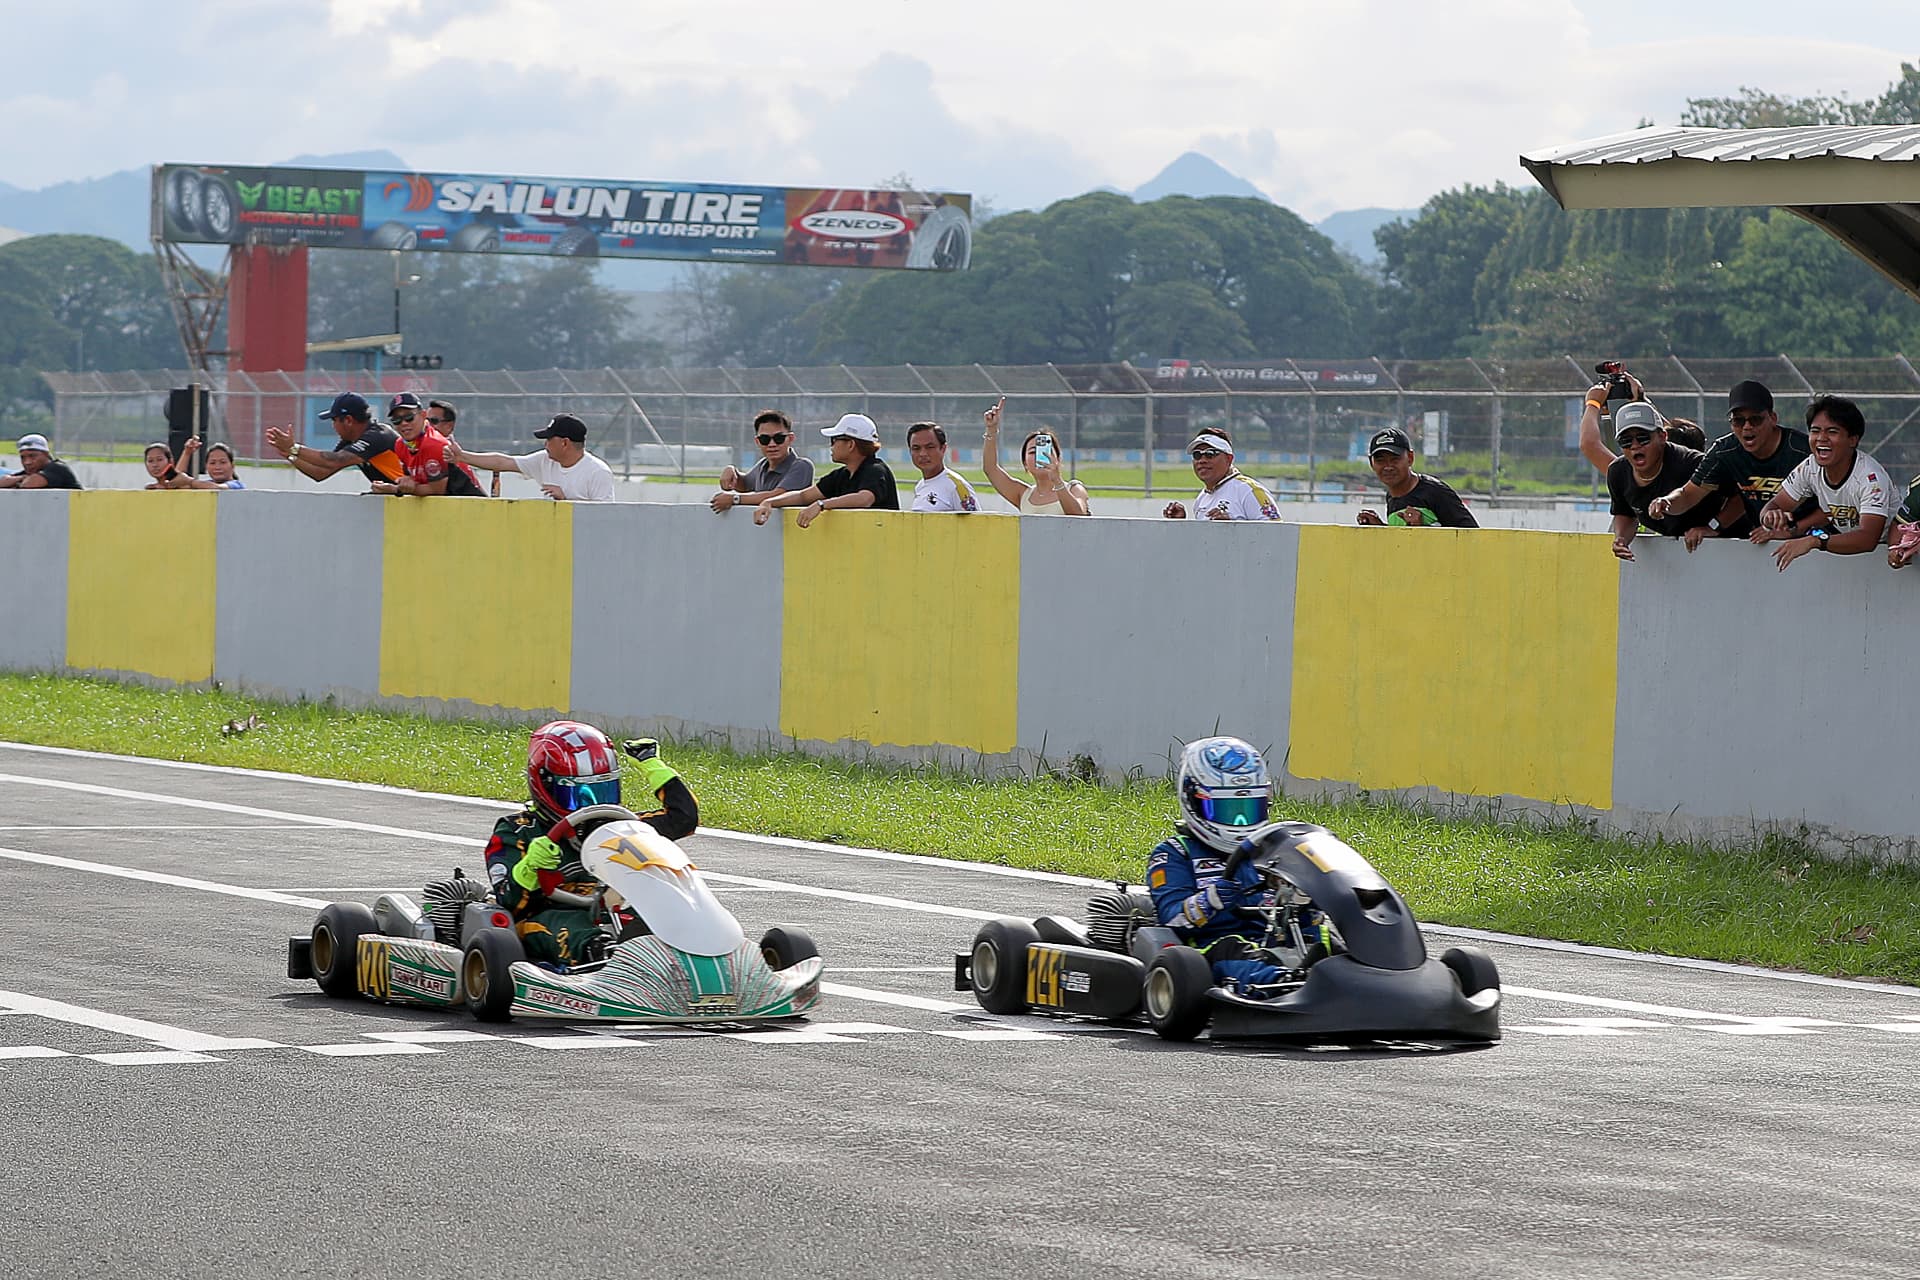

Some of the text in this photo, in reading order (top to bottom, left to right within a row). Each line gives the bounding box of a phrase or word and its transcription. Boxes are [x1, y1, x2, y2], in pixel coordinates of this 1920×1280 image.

[266, 185, 361, 214] BEAST
[437, 180, 763, 225] SAILUN TIRE
[611, 220, 760, 239] MOTORSPORT
[807, 217, 897, 230] ZENEOS
